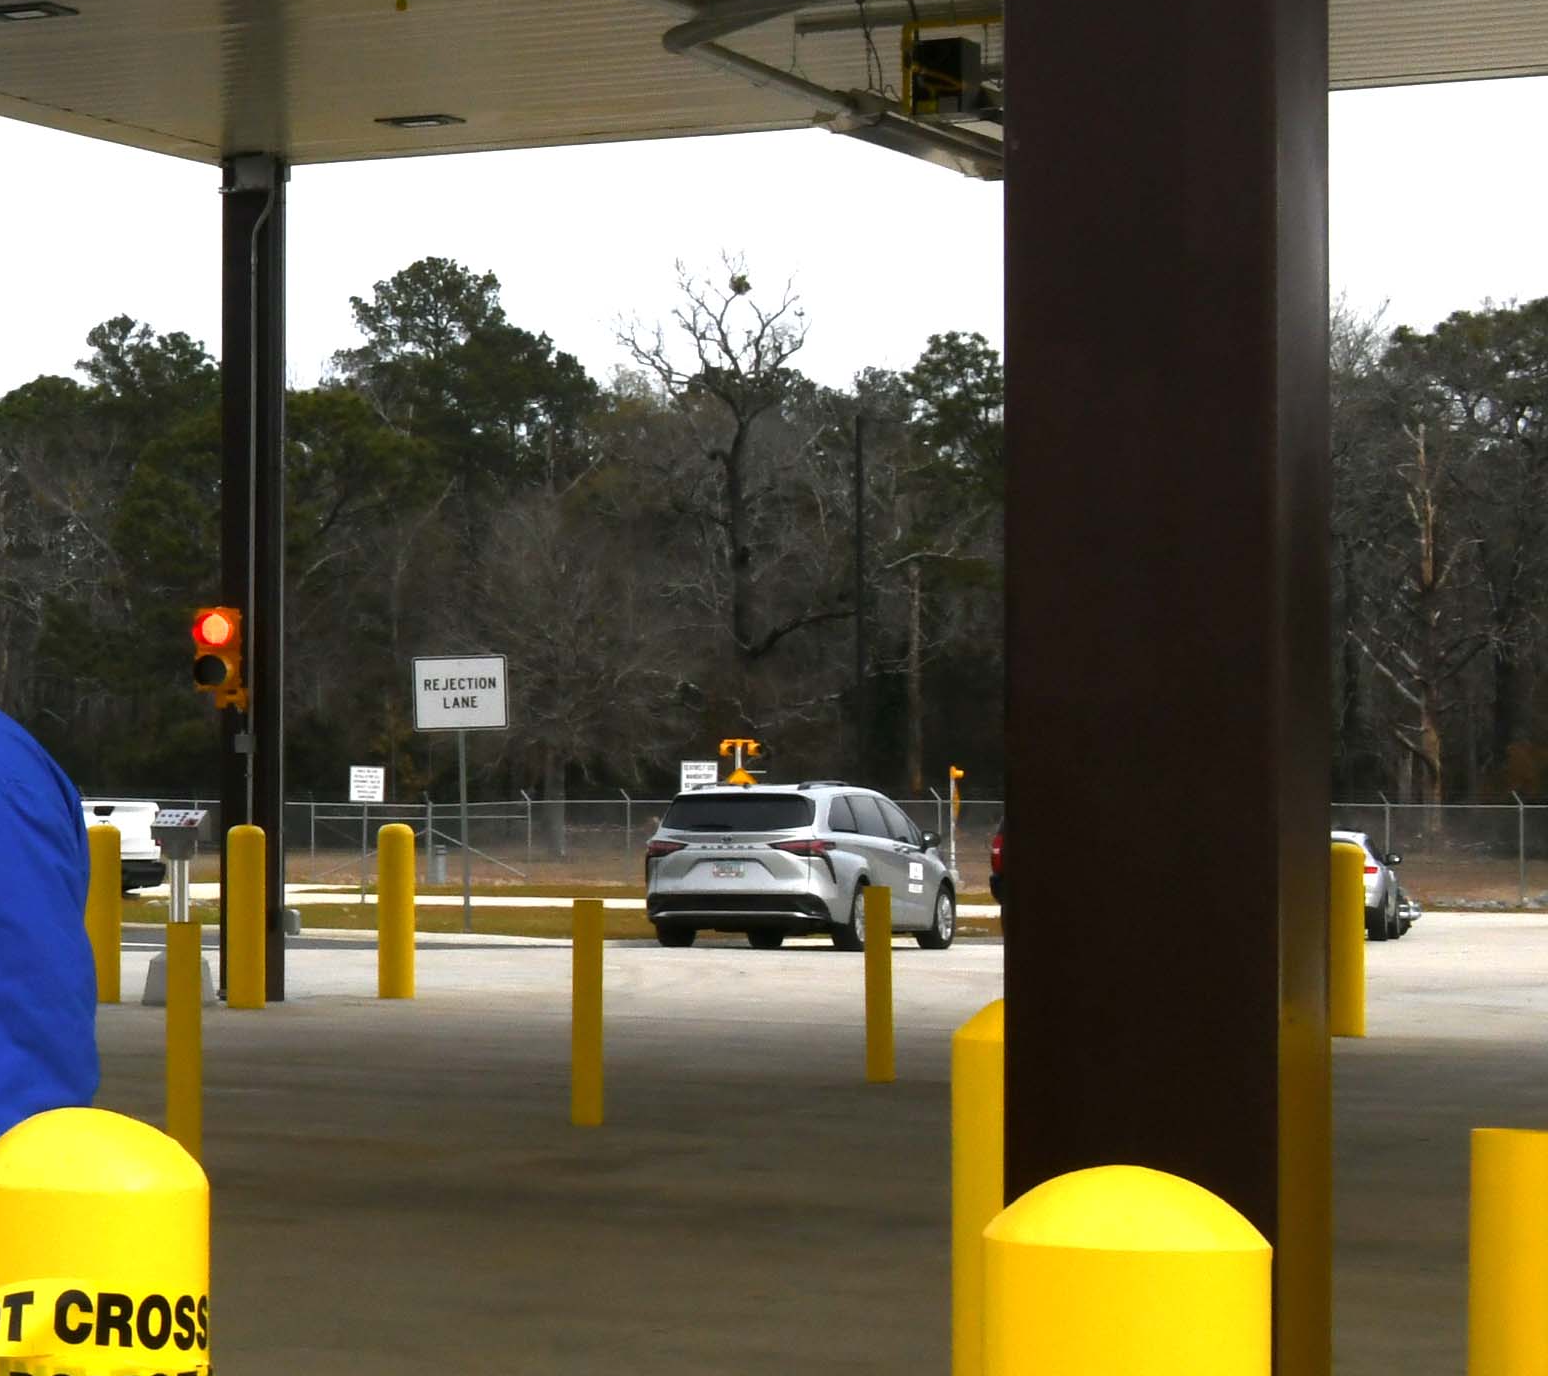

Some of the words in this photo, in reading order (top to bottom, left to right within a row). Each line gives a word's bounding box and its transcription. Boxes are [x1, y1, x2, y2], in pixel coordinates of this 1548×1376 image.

[424, 677, 496, 691] REJECTION
[443, 696, 478, 708] LANE
[53, 1289, 208, 1351] CROSS
